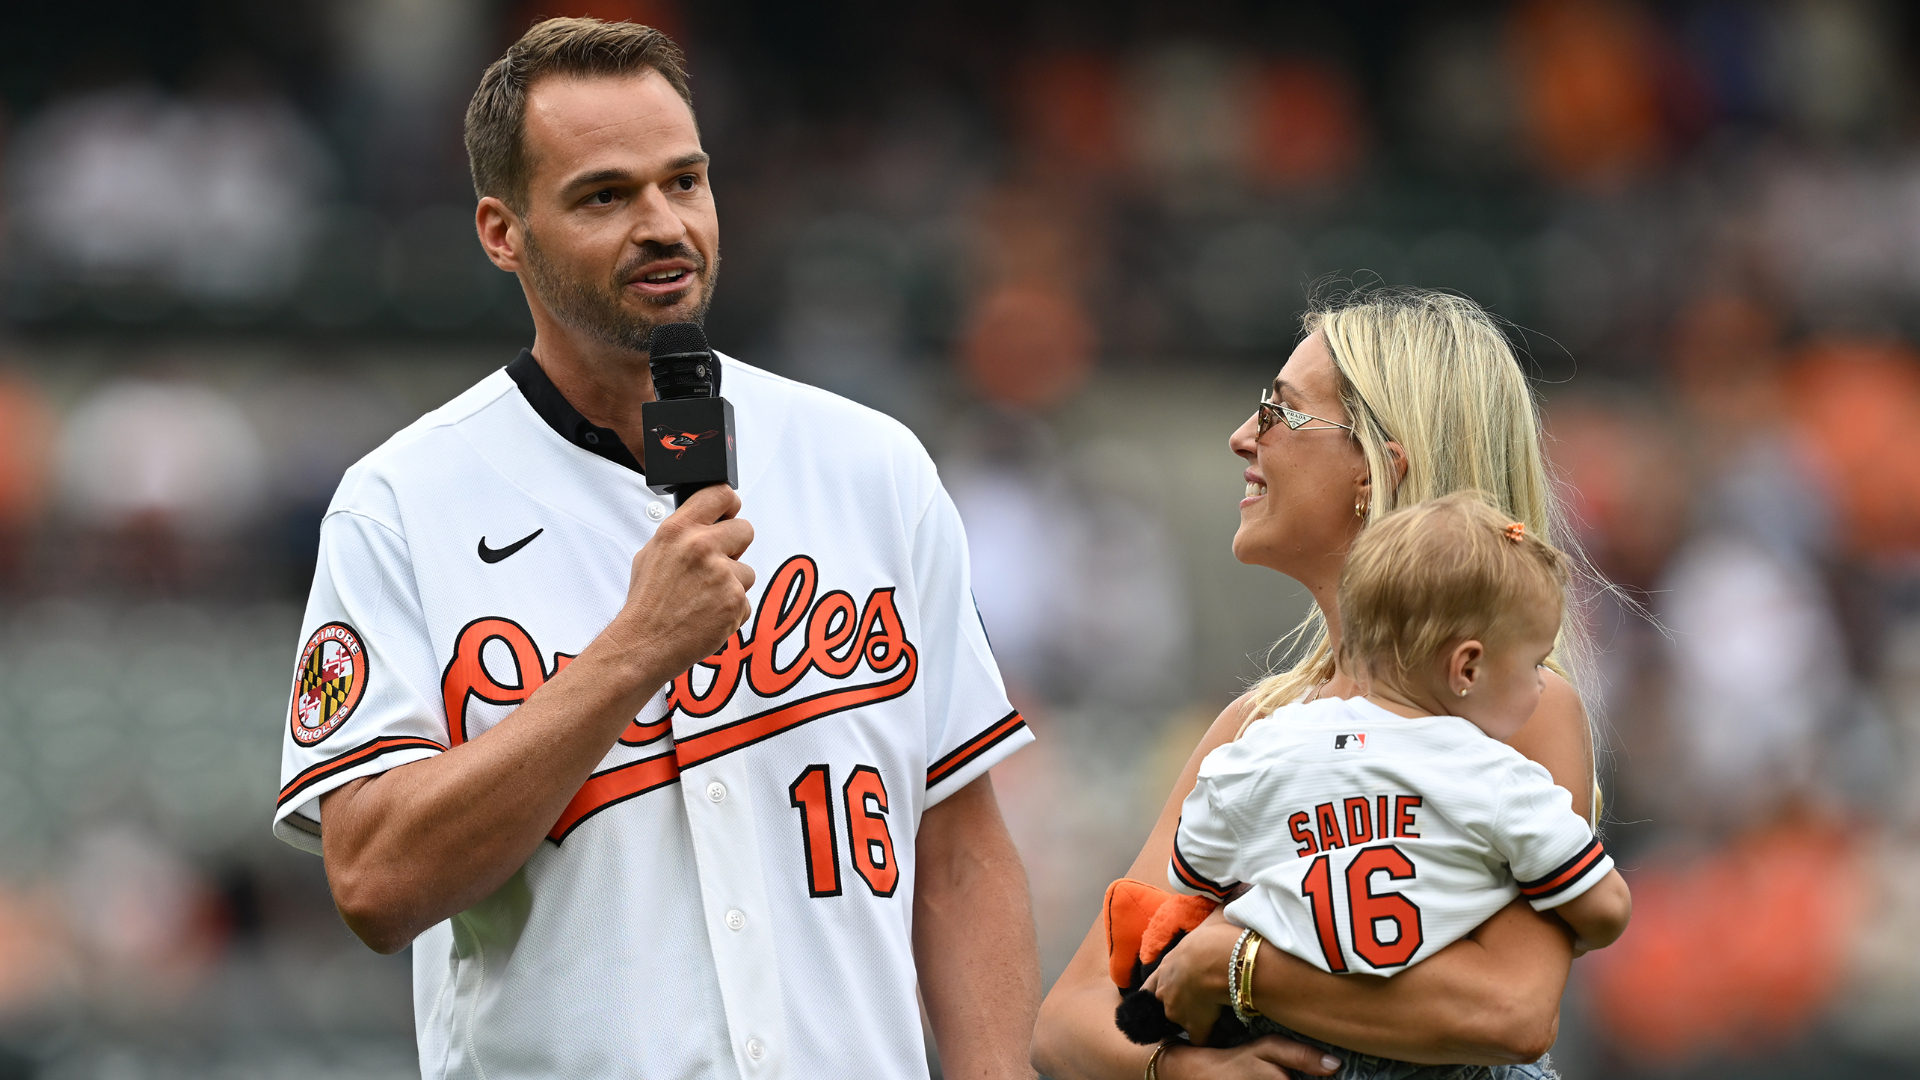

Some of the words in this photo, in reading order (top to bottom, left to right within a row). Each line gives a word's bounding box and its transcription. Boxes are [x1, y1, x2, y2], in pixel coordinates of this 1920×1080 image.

[1286, 411, 1307, 421] PRADA
[297, 627, 361, 682] BALTIMORE
[441, 554, 918, 746] Ooles
[296, 705, 349, 741] ORIOLES
[788, 763, 900, 898] 16
[1287, 794, 1423, 858] SADIE
[1301, 844, 1424, 974] 16
